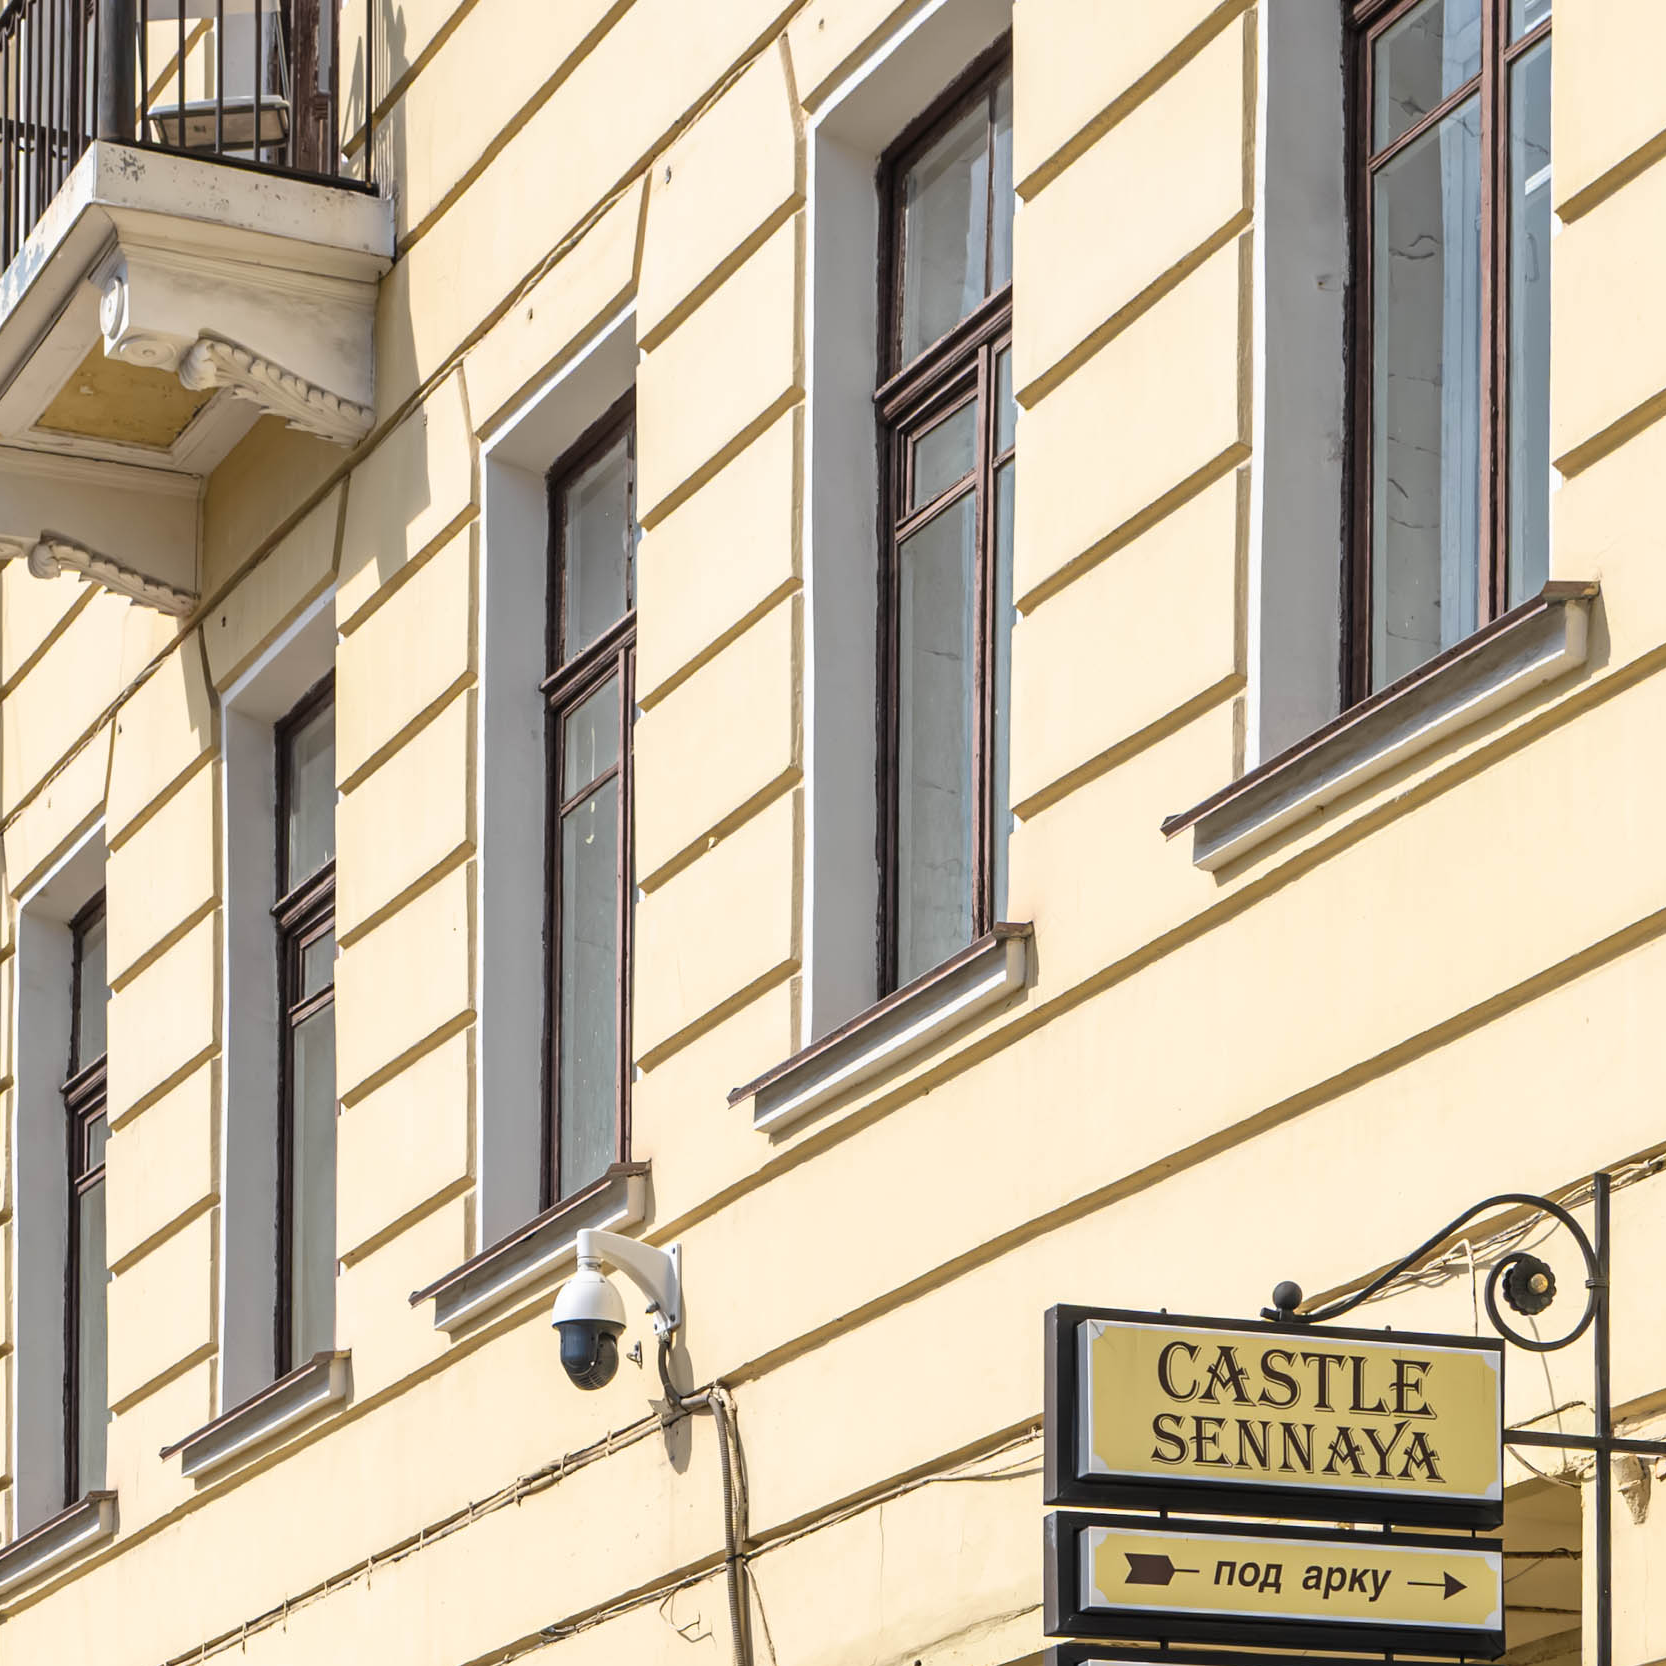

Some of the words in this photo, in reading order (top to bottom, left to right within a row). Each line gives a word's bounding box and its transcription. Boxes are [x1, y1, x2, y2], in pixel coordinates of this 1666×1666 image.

[1157, 1340, 1438, 1420] CASTLE
[1150, 1412, 1446, 1484] SENNAYA
[1213, 1557, 1284, 1594] под
[1301, 1563, 1392, 1603] арку
